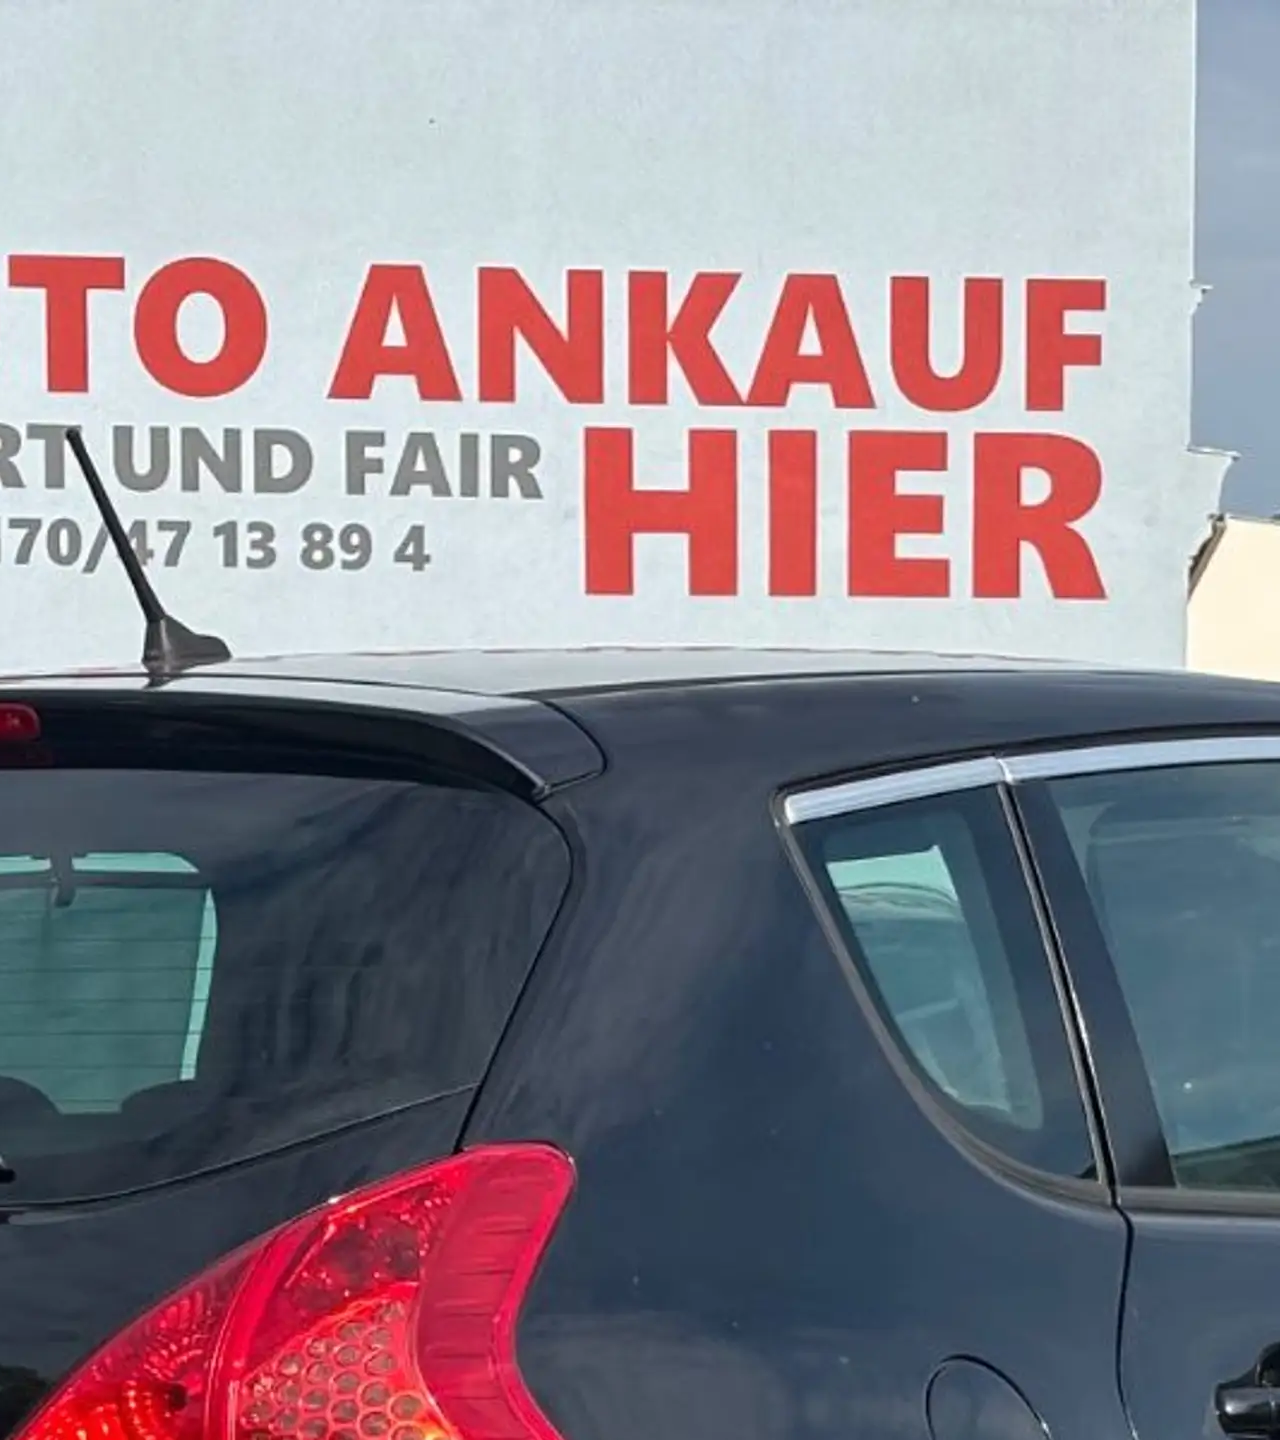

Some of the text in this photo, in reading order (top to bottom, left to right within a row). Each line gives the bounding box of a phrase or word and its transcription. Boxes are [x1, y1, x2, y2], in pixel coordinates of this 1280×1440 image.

[328, 264, 1107, 412] ANKAUF
[112, 425, 314, 494] UND
[345, 430, 544, 500] FAIR
[584, 426, 1107, 600] HIER
[212, 520, 277, 570] 13
[300, 522, 373, 571] 89
[393, 524, 431, 572] 4
